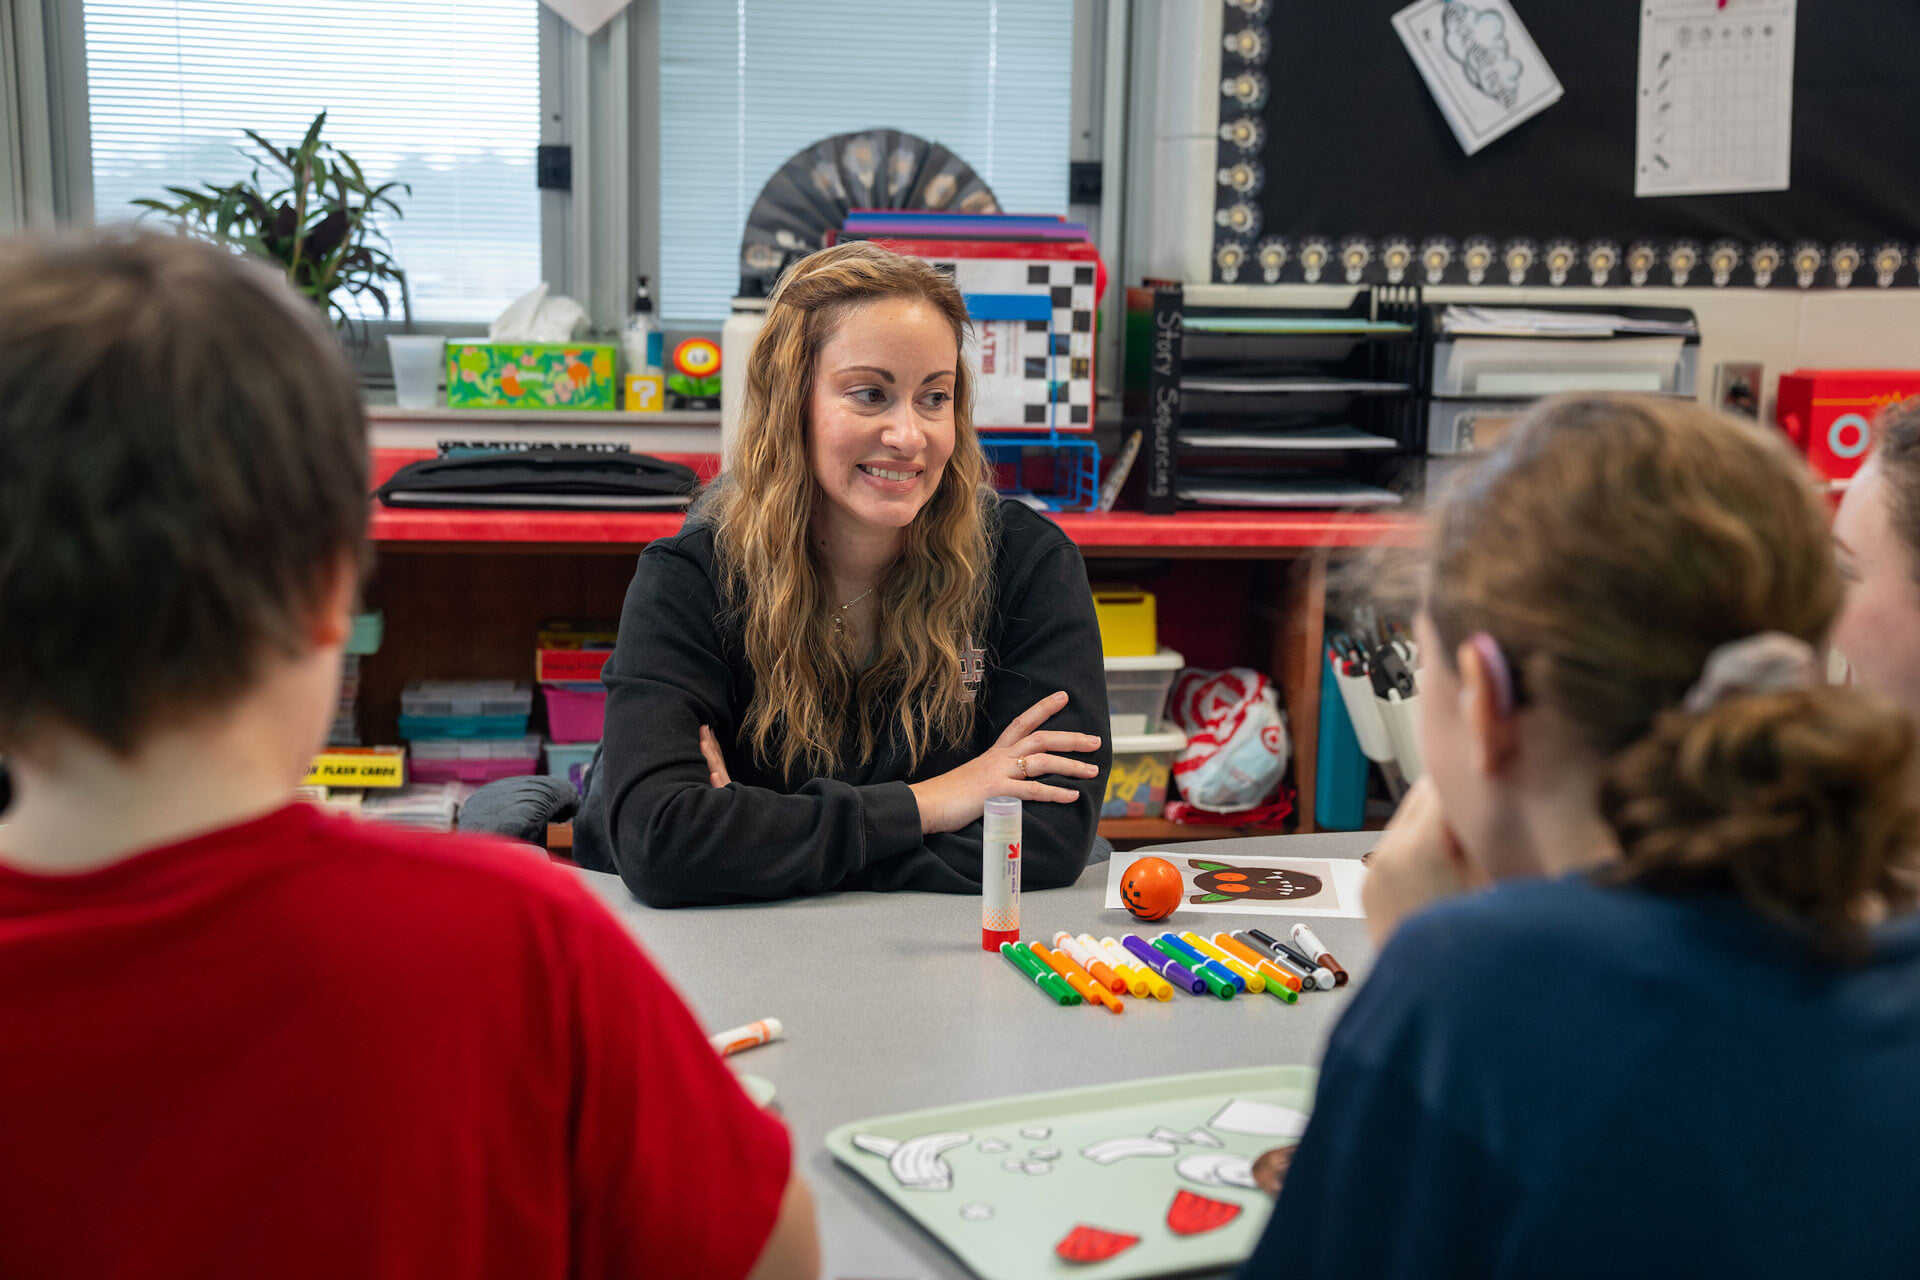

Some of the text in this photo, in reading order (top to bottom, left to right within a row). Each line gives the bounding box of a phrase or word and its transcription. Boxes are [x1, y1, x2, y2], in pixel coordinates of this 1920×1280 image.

[632, 380, 657, 409] ?
[1148, 311, 1182, 497] Story Sequencing
[323, 765, 357, 776] FLASH
[360, 766, 396, 777] CARDS
